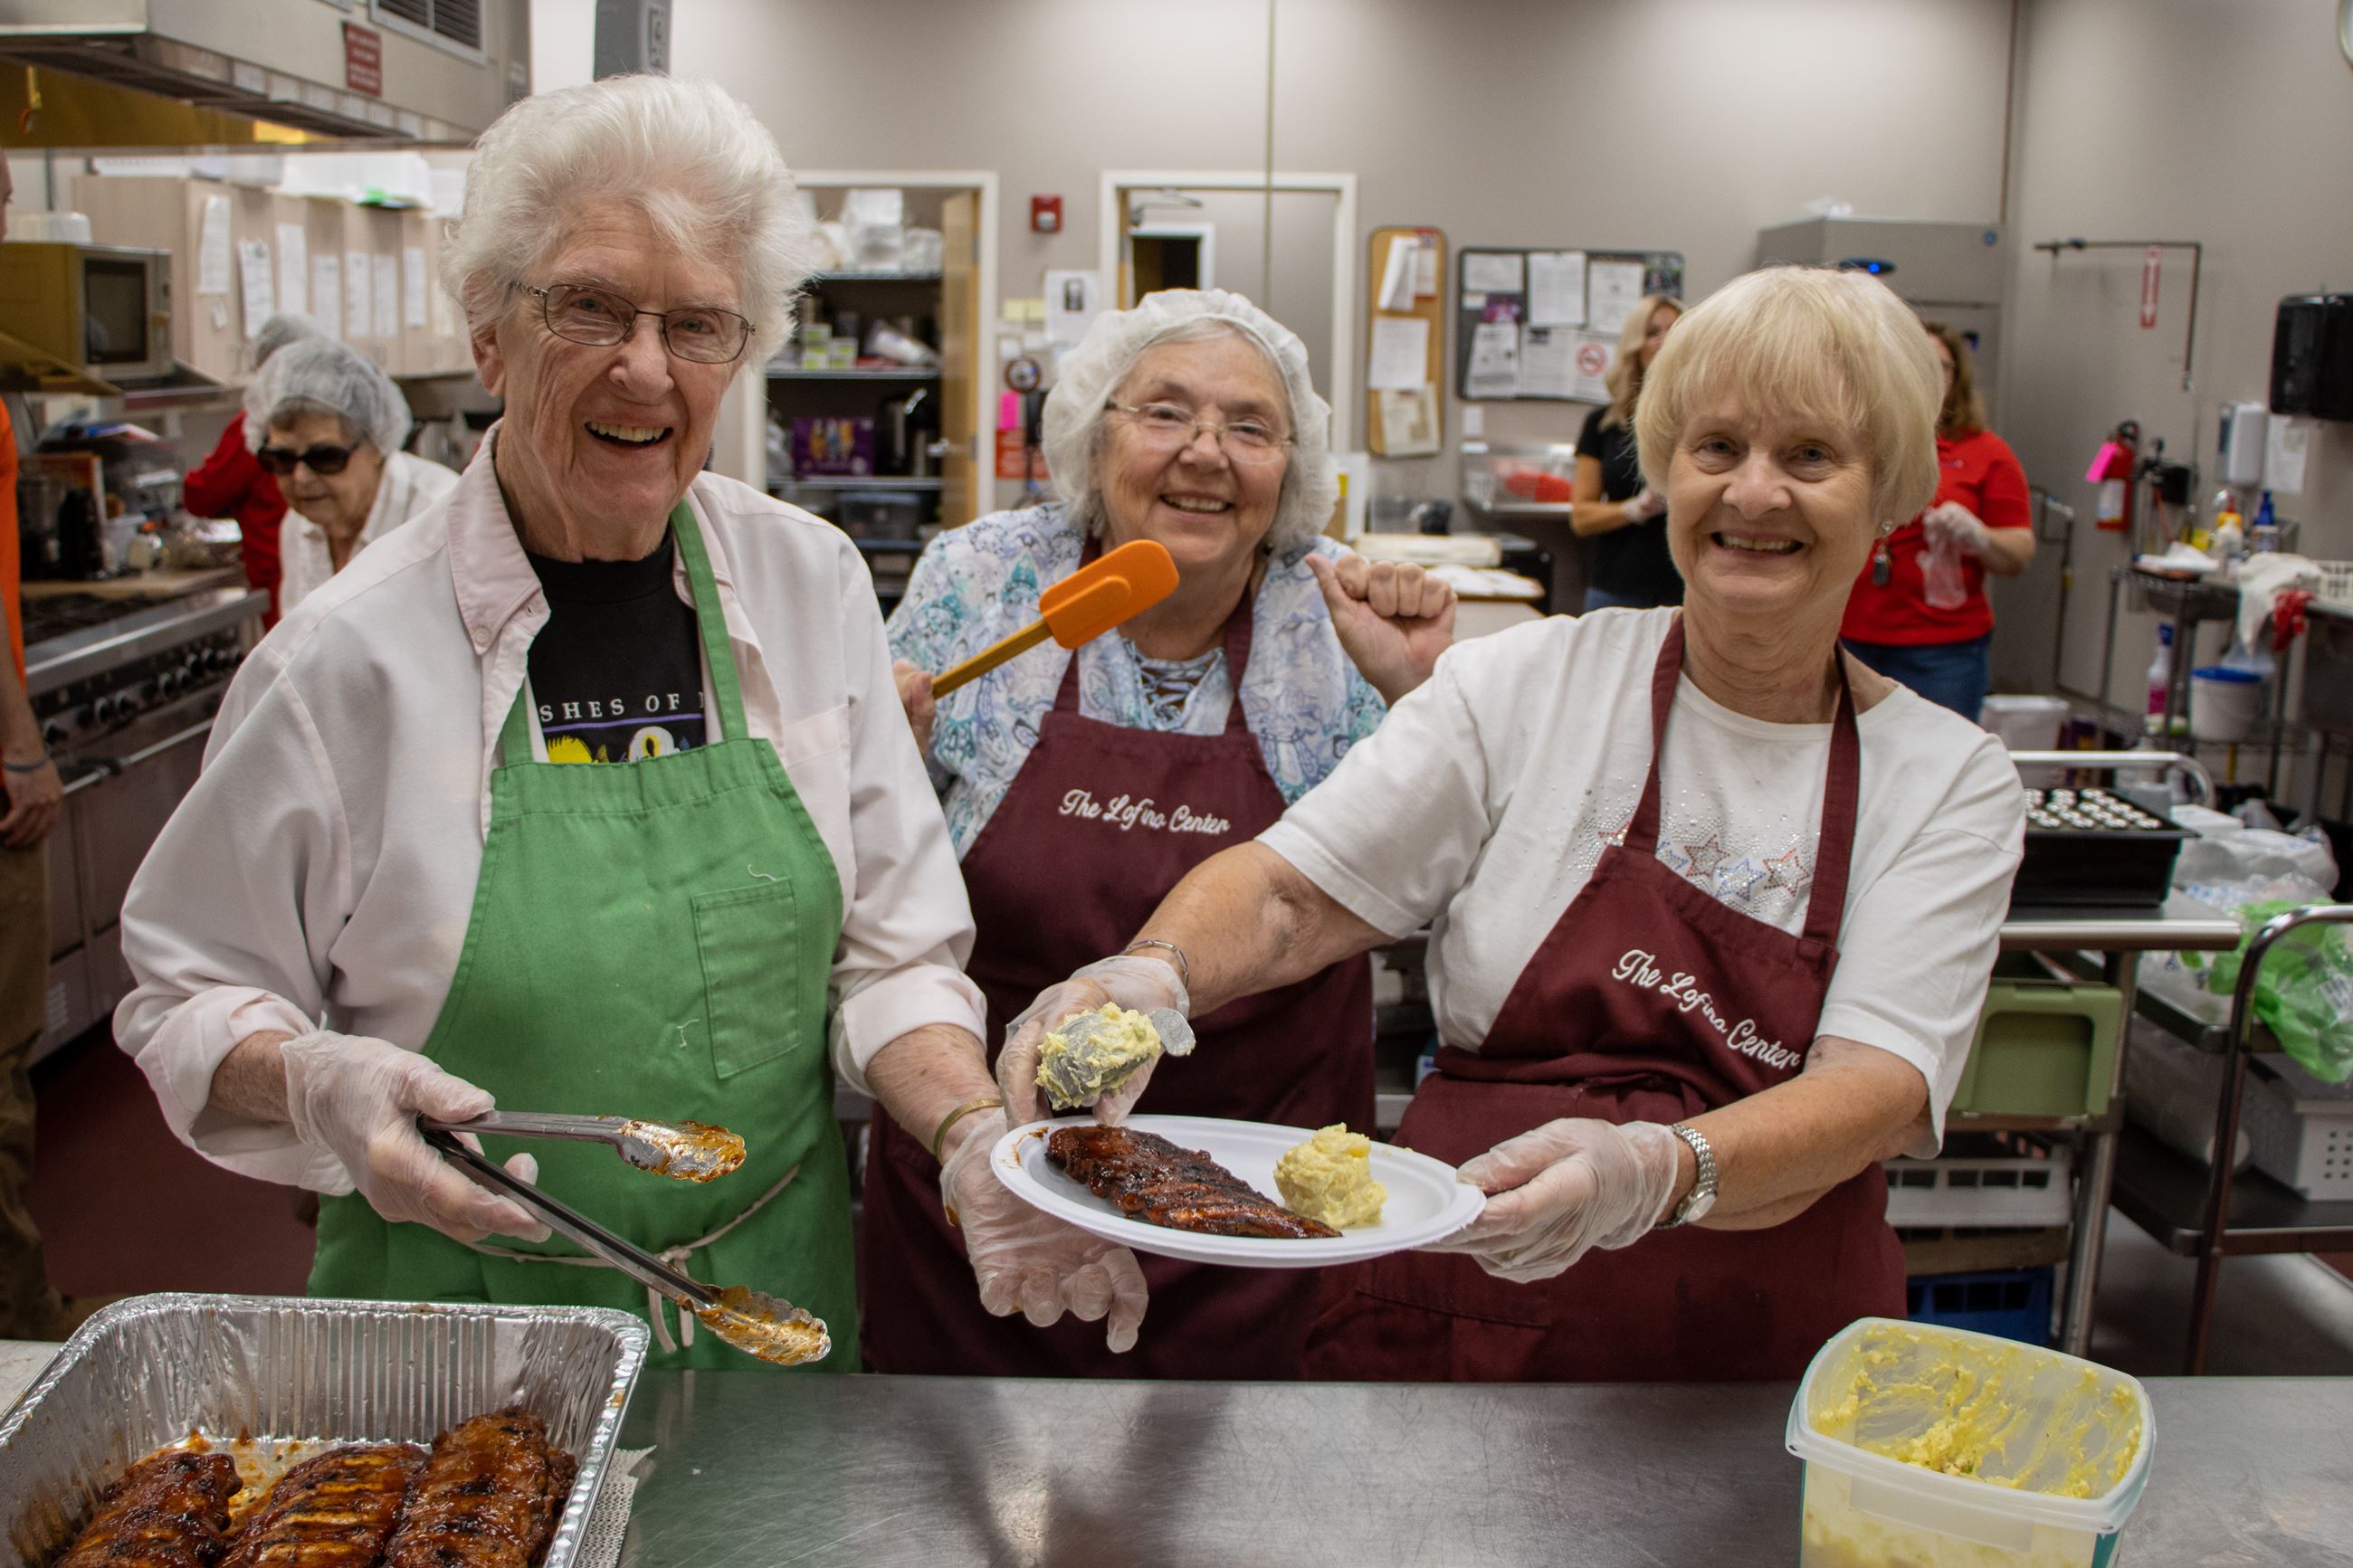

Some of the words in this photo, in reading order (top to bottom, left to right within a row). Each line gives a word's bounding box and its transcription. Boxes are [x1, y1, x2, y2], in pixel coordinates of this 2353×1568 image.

[645, 693, 680, 712] OF
[1059, 789, 1102, 819] The
[1169, 804, 1231, 834] Center
[1612, 949, 1662, 988] The
[1726, 1018, 1800, 1069] Center
